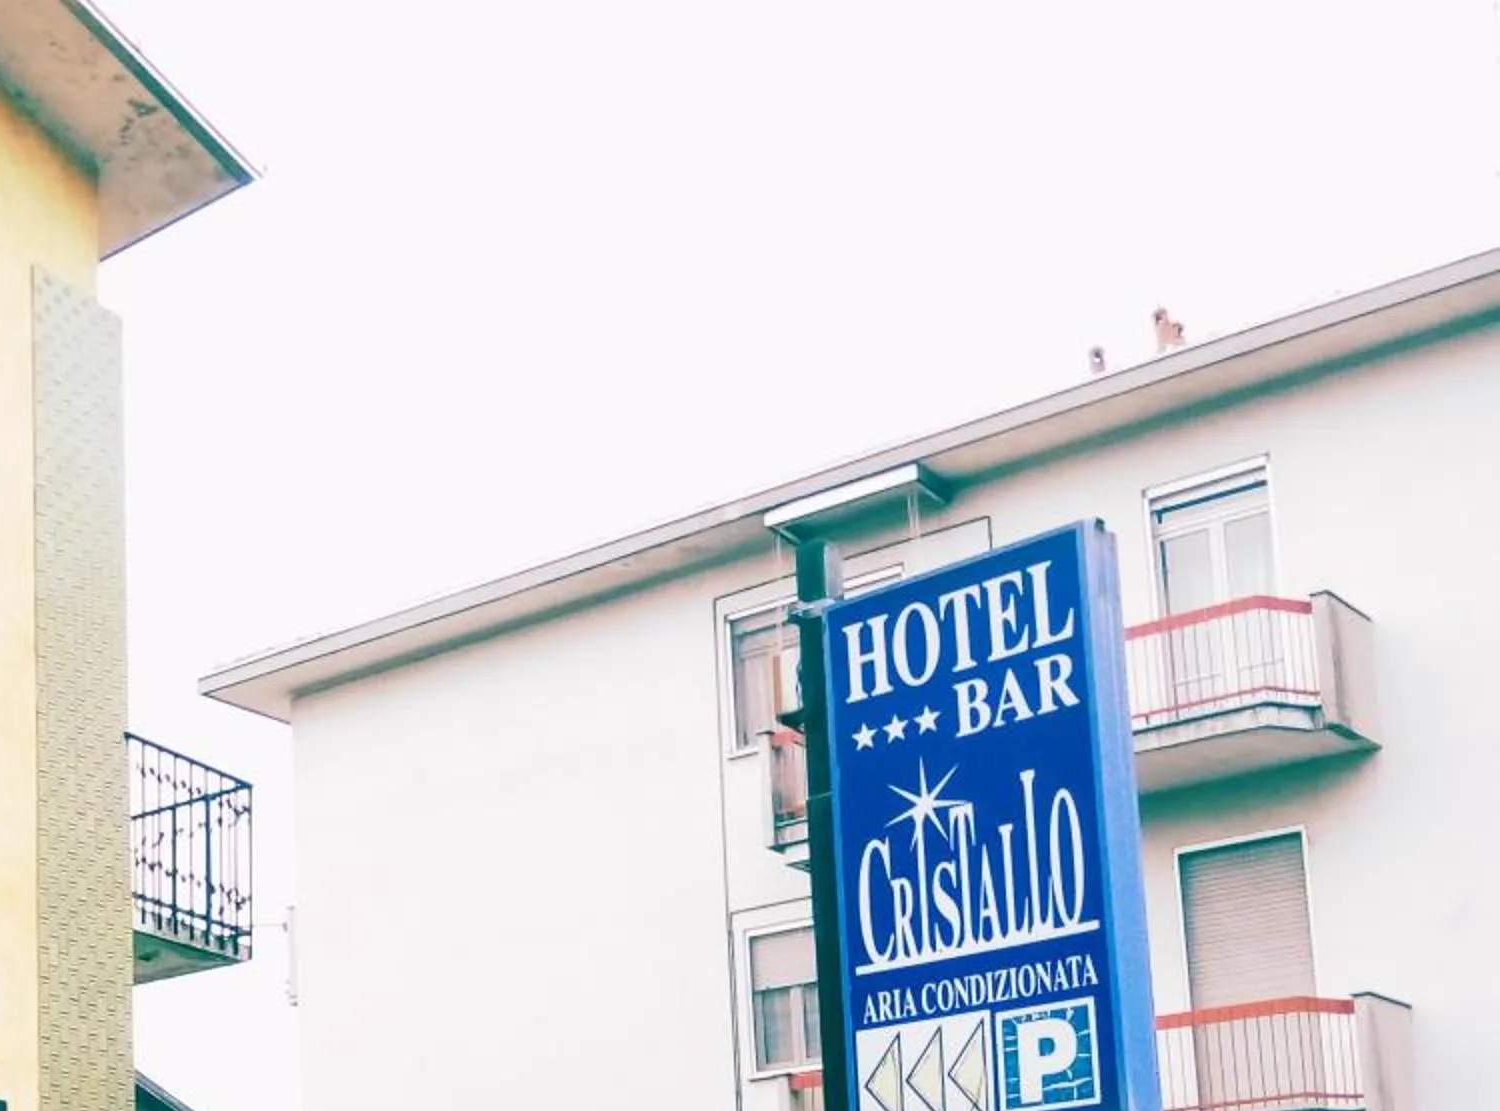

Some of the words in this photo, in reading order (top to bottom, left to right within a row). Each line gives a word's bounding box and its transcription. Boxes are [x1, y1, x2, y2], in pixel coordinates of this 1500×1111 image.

[842, 560, 1075, 704] HOTEL
[953, 653, 1081, 738] BAR
[856, 768, 1088, 970] CRISTALLO
[862, 986, 918, 1025] ARIA
[920, 953, 1099, 1016] CONDIZIONATA
[1016, 1015, 1077, 1104] P
